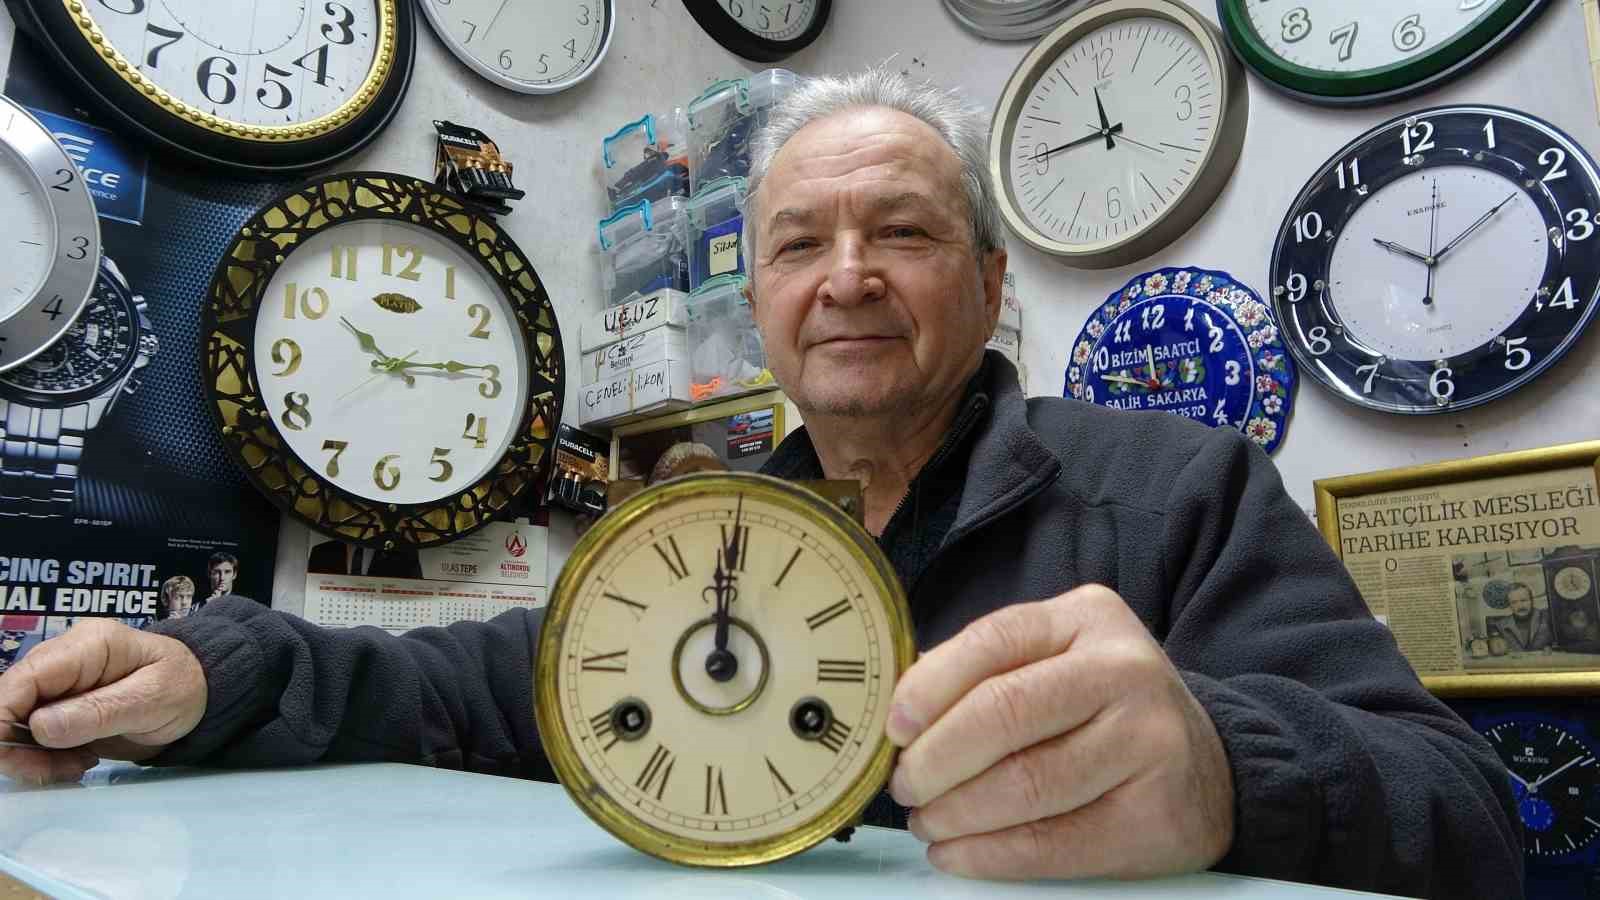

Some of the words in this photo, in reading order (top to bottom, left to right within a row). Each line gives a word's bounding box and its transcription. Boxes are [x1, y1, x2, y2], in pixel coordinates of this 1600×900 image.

[321, 1, 356, 45] 3
[576, 3, 590, 26] 3
[1281, 7, 1313, 44] 8
[146, 22, 185, 69] 7
[461, 20, 478, 44] 7
[562, 37, 577, 59] 4
[1329, 21, 1359, 62] 7
[1391, 14, 1426, 52] 6
[292, 43, 336, 88] 4
[497, 48, 513, 71] 6
[536, 53, 550, 75] 5
[1091, 47, 1115, 81] 12
[196, 55, 237, 105] 6
[256, 63, 293, 110] 5
[1174, 84, 1193, 121] 3
[1400, 120, 1436, 155] 12
[1482, 118, 1496, 149] 1
[1033, 141, 1050, 176] 9
[1334, 157, 1361, 190] 11
[1538, 147, 1568, 182] 2
[51, 168, 75, 192] 2
[1105, 186, 1122, 220] 6
[1293, 211, 1323, 243] 10
[1565, 207, 1595, 241] 3
[66, 235, 90, 260] 3
[330, 245, 359, 282] 11
[383, 241, 425, 282] 12
[444, 267, 457, 300] 1
[1286, 272, 1308, 302] 9
[1549, 276, 1580, 310] 4
[41, 293, 63, 321] 4
[281, 281, 330, 321] 10
[1142, 303, 1166, 331] 12
[466, 303, 491, 340] 2
[1114, 318, 1132, 344] 11
[1184, 307, 1195, 332] 1
[1207, 326, 1225, 354] 2
[1308, 326, 1332, 356] 8
[1504, 336, 1532, 371] 5
[271, 337, 302, 377] 9
[1092, 346, 1110, 374] 10
[1111, 348, 1149, 368] BİZİM
[1225, 359, 1241, 386] 3
[478, 364, 503, 399] 3
[1085, 385, 1095, 404] 9
[1355, 363, 1380, 394] 7
[1429, 366, 1455, 399] 6
[281, 391, 312, 431] 8
[1147, 387, 1208, 407] SAKARYA
[1213, 398, 1229, 425] 4
[462, 412, 488, 449] 4
[321, 439, 349, 478] 7
[559, 438, 594, 457] DURACELL
[372, 453, 401, 492] 6
[428, 446, 454, 483] 5
[1341, 496, 1468, 531] SAATÇİLİK
[1473, 482, 1594, 518] MESLEĞİ
[1343, 530, 1431, 554] TARİHE
[1436, 516, 1580, 547] KARIŞIYOR
[66, 560, 160, 588] SPIRIT.
[54, 588, 160, 614] EDIFICE
[806, 598, 853, 631] II
[817, 659, 866, 683] III
